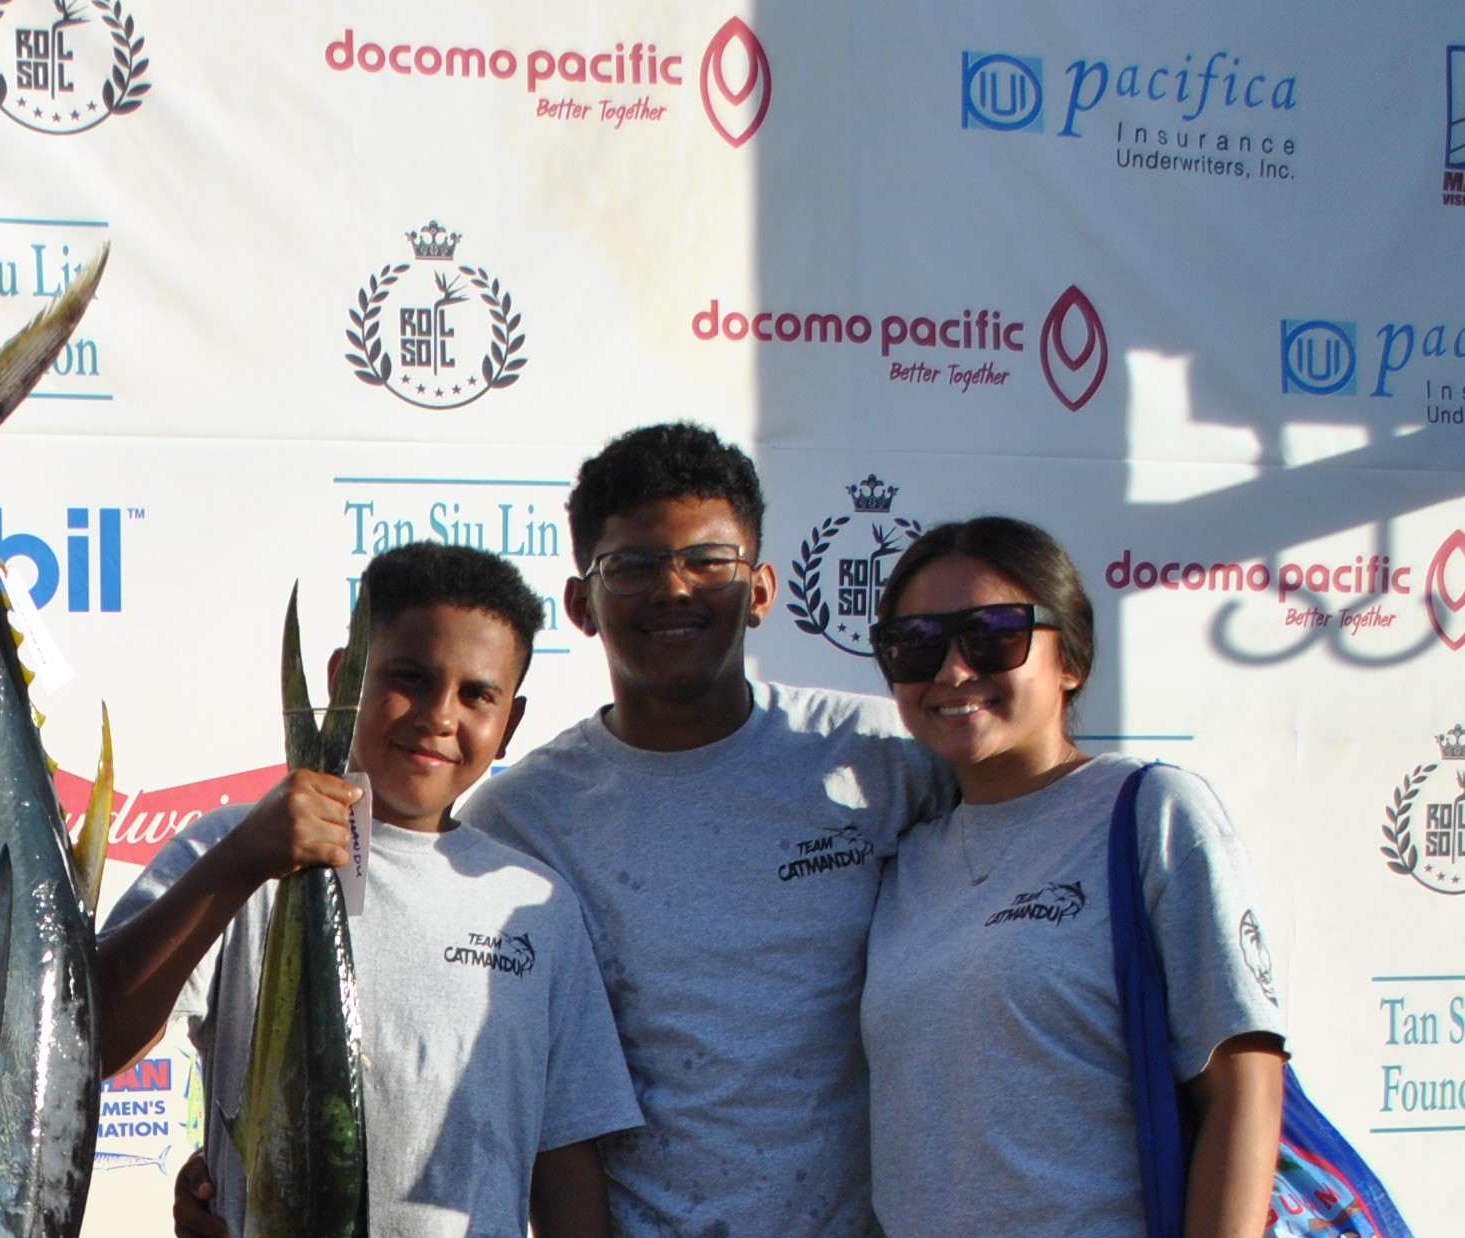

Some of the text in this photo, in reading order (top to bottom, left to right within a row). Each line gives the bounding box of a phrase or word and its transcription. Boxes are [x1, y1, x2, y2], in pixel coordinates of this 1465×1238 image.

[324, 29, 683, 92] docomo pacific
[1057, 52, 1297, 138] pacifica
[536, 97, 668, 130] Better Together
[1117, 121, 1296, 155] Insurance
[1116, 149, 1295, 180] Underwriters, Inc.
[31, 243, 98, 300] Li
[691, 298, 1025, 357] docomo pacific
[889, 361, 1011, 393] Better Together
[344, 499, 560, 557] Tan Siu Lin
[1105, 549, 1412, 603] docomo pacific
[1284, 605, 1397, 636] Better Together
[796, 836, 833, 856] TEAM
[468, 932, 503, 950] TEAM
[443, 946, 521, 976] CATMANDU
[1379, 996, 1439, 1046] Tan
[98, 1121, 169, 1138] IATION
